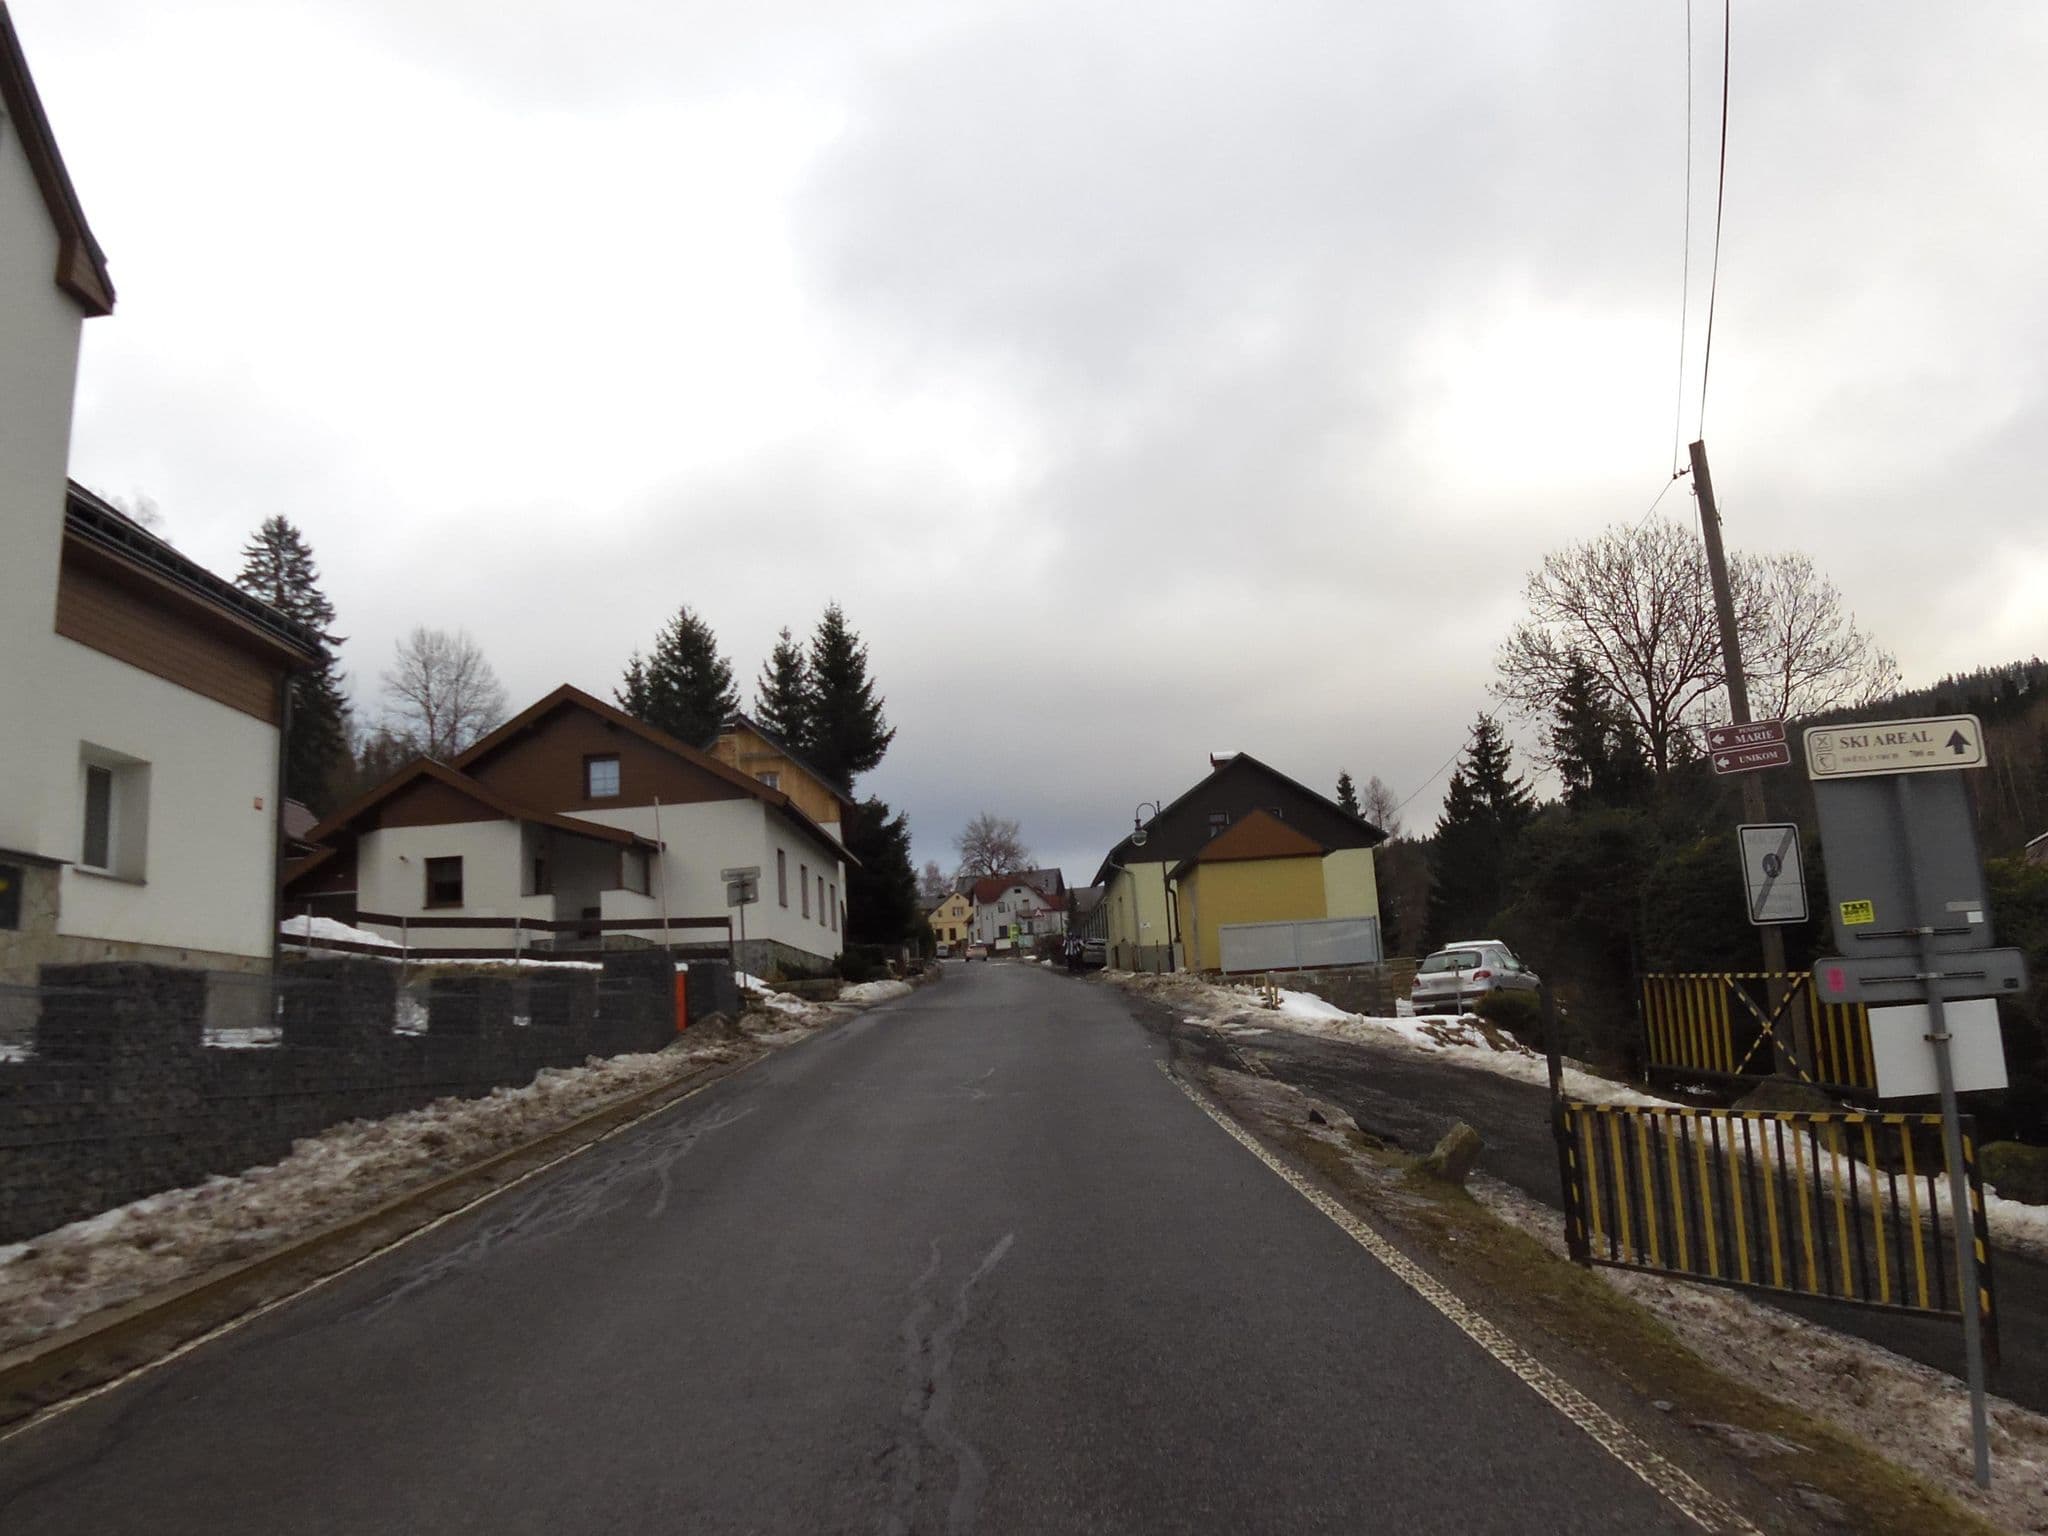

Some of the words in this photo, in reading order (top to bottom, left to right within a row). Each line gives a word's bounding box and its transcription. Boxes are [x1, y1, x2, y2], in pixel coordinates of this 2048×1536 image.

[1734, 730, 1775, 744] MARIE
[1839, 734, 1870, 750] SKI
[1872, 730, 1934, 748] AREAL
[1738, 750, 1778, 764] UNIKOM
